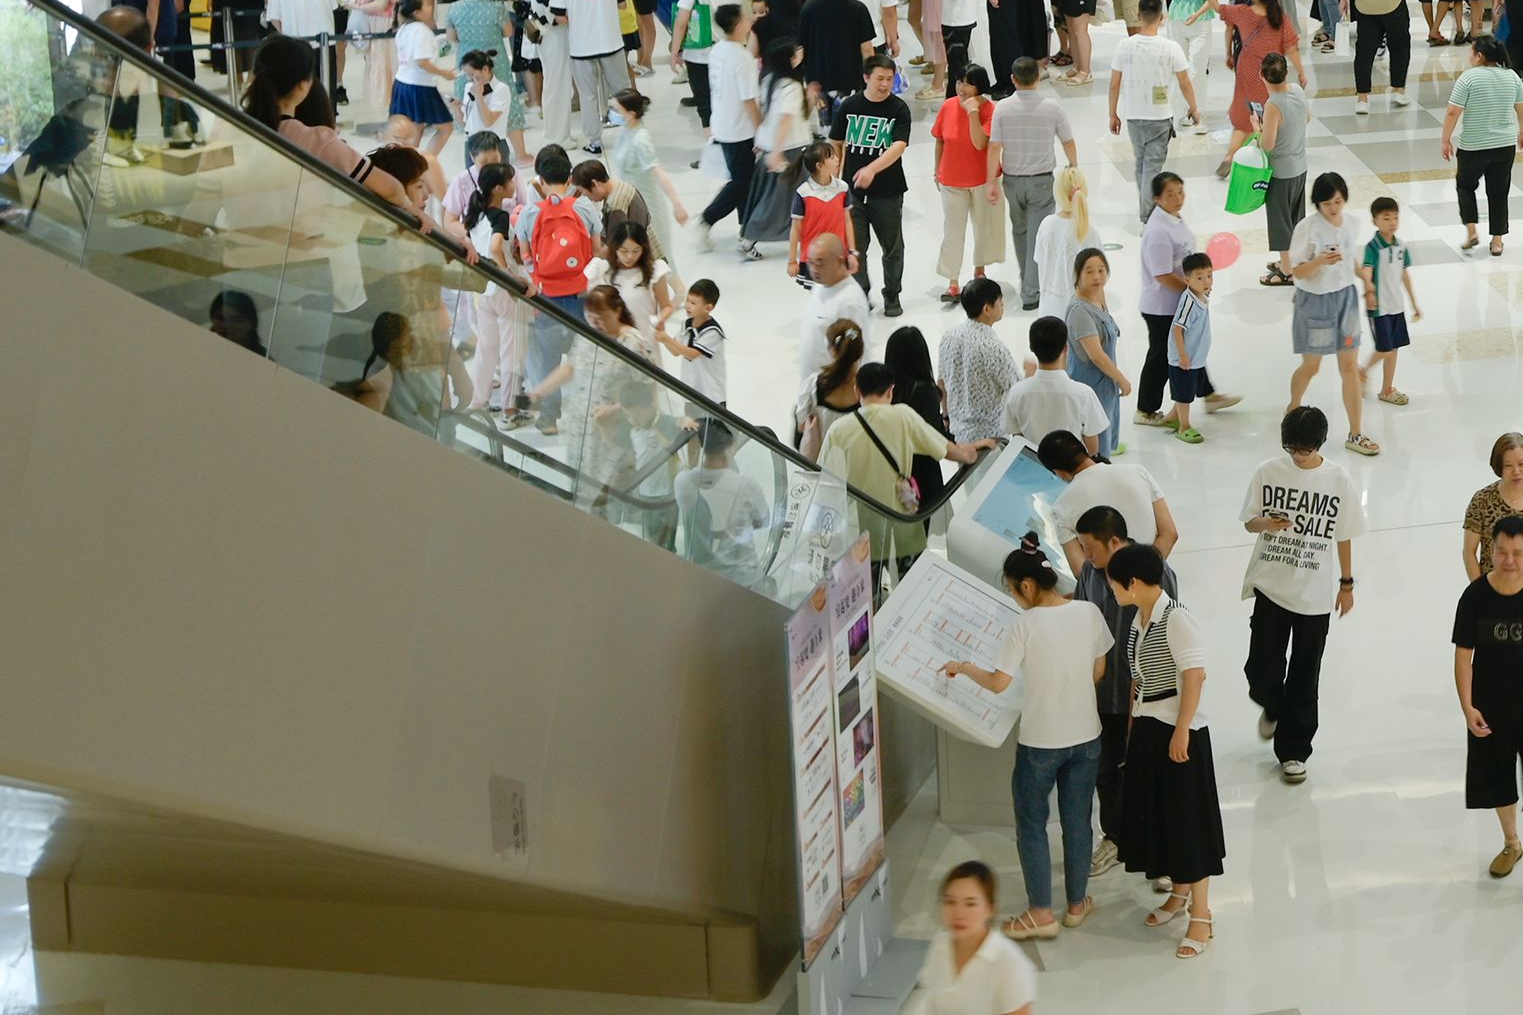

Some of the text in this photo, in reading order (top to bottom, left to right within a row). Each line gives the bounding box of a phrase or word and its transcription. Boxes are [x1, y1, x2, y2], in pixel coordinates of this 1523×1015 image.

[846, 114, 896, 150] NEW
[1262, 485, 1341, 519] DREAMS
[1293, 514, 1337, 540] SALE
[1267, 544, 1291, 555] DREAM
[1292, 548, 1302, 559] ALL
[1278, 536, 1301, 547] DREAM
[1281, 555, 1294, 566] FOR
[1299, 560, 1320, 571] LIVING
